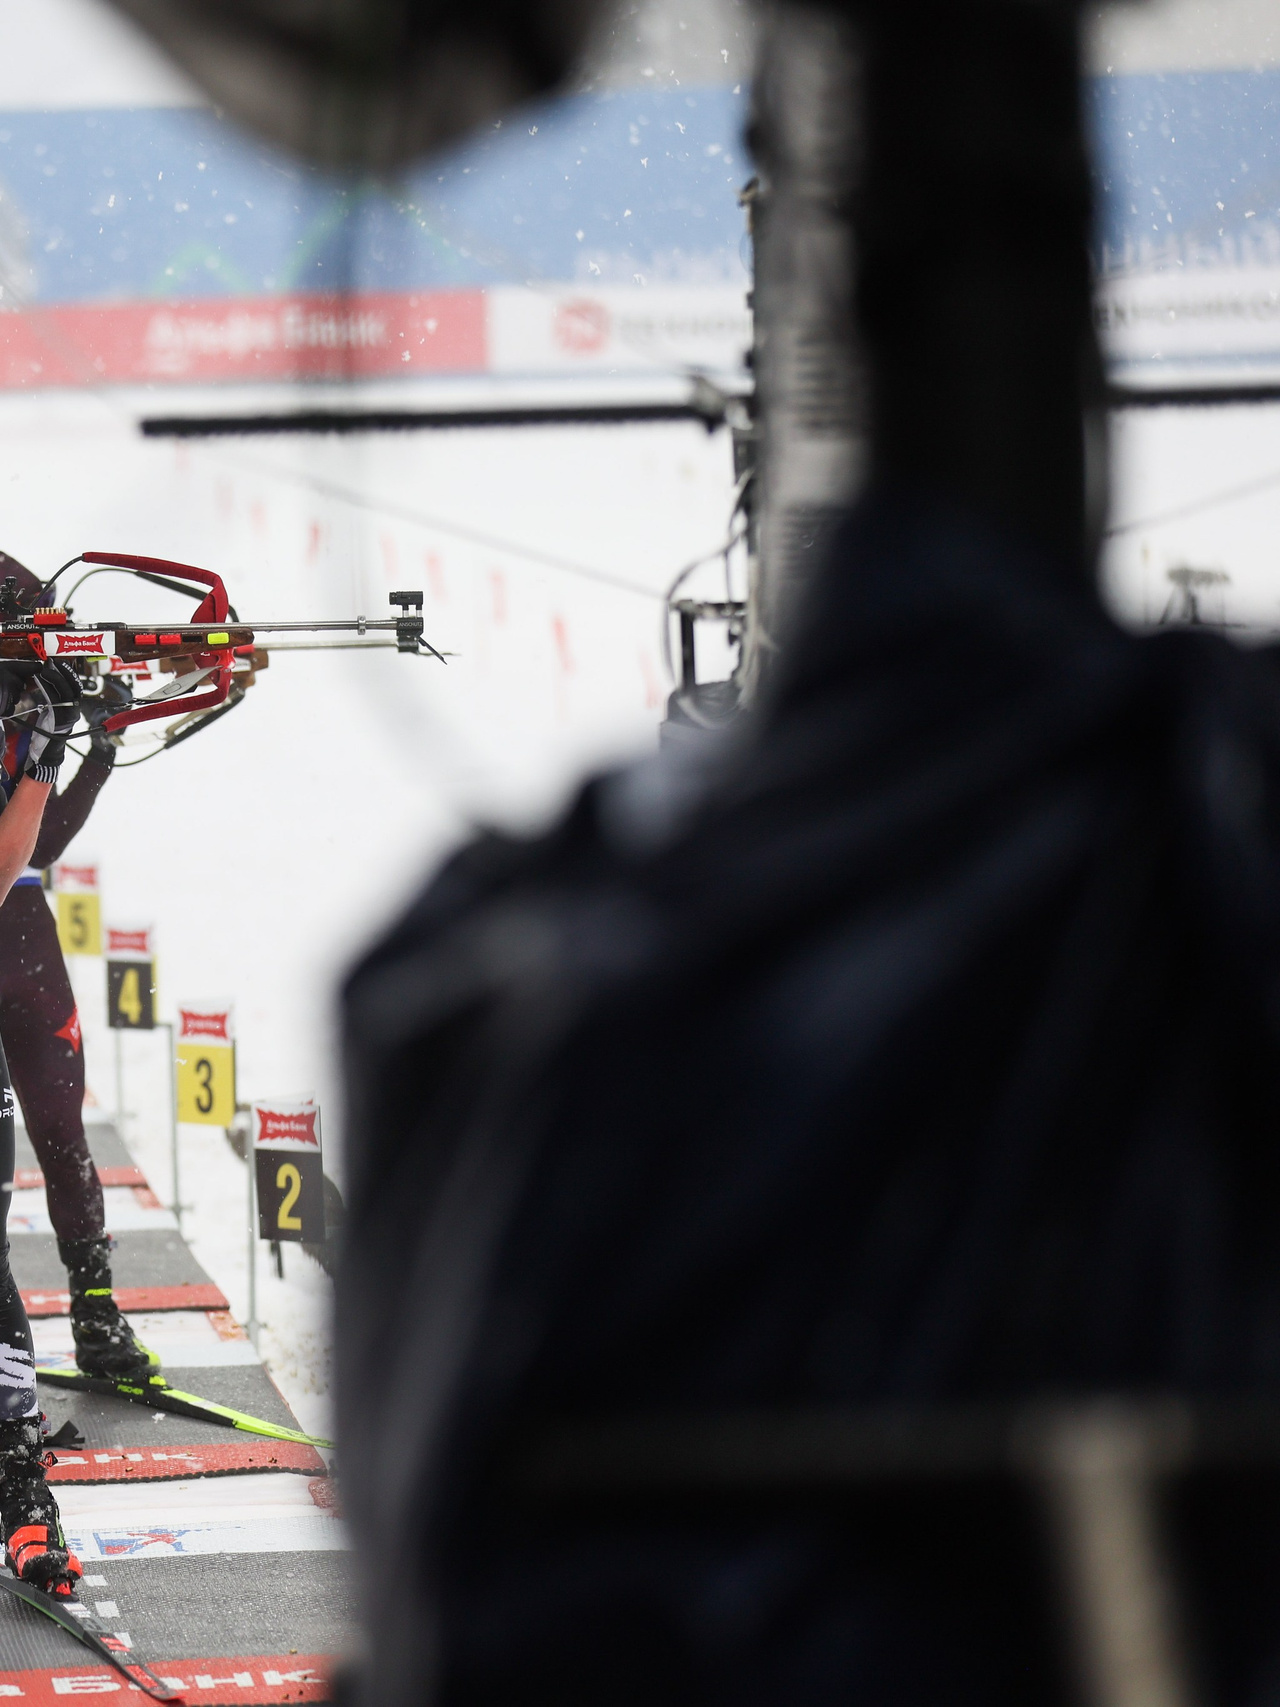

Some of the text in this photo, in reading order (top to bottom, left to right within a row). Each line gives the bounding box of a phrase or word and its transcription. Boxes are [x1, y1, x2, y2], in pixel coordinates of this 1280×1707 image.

[63, 640, 82, 649] Альфа
[69, 901, 90, 948] 5
[118, 968, 143, 1025] 4
[195, 1058, 214, 1115] 3
[276, 1163, 301, 1231] 2
